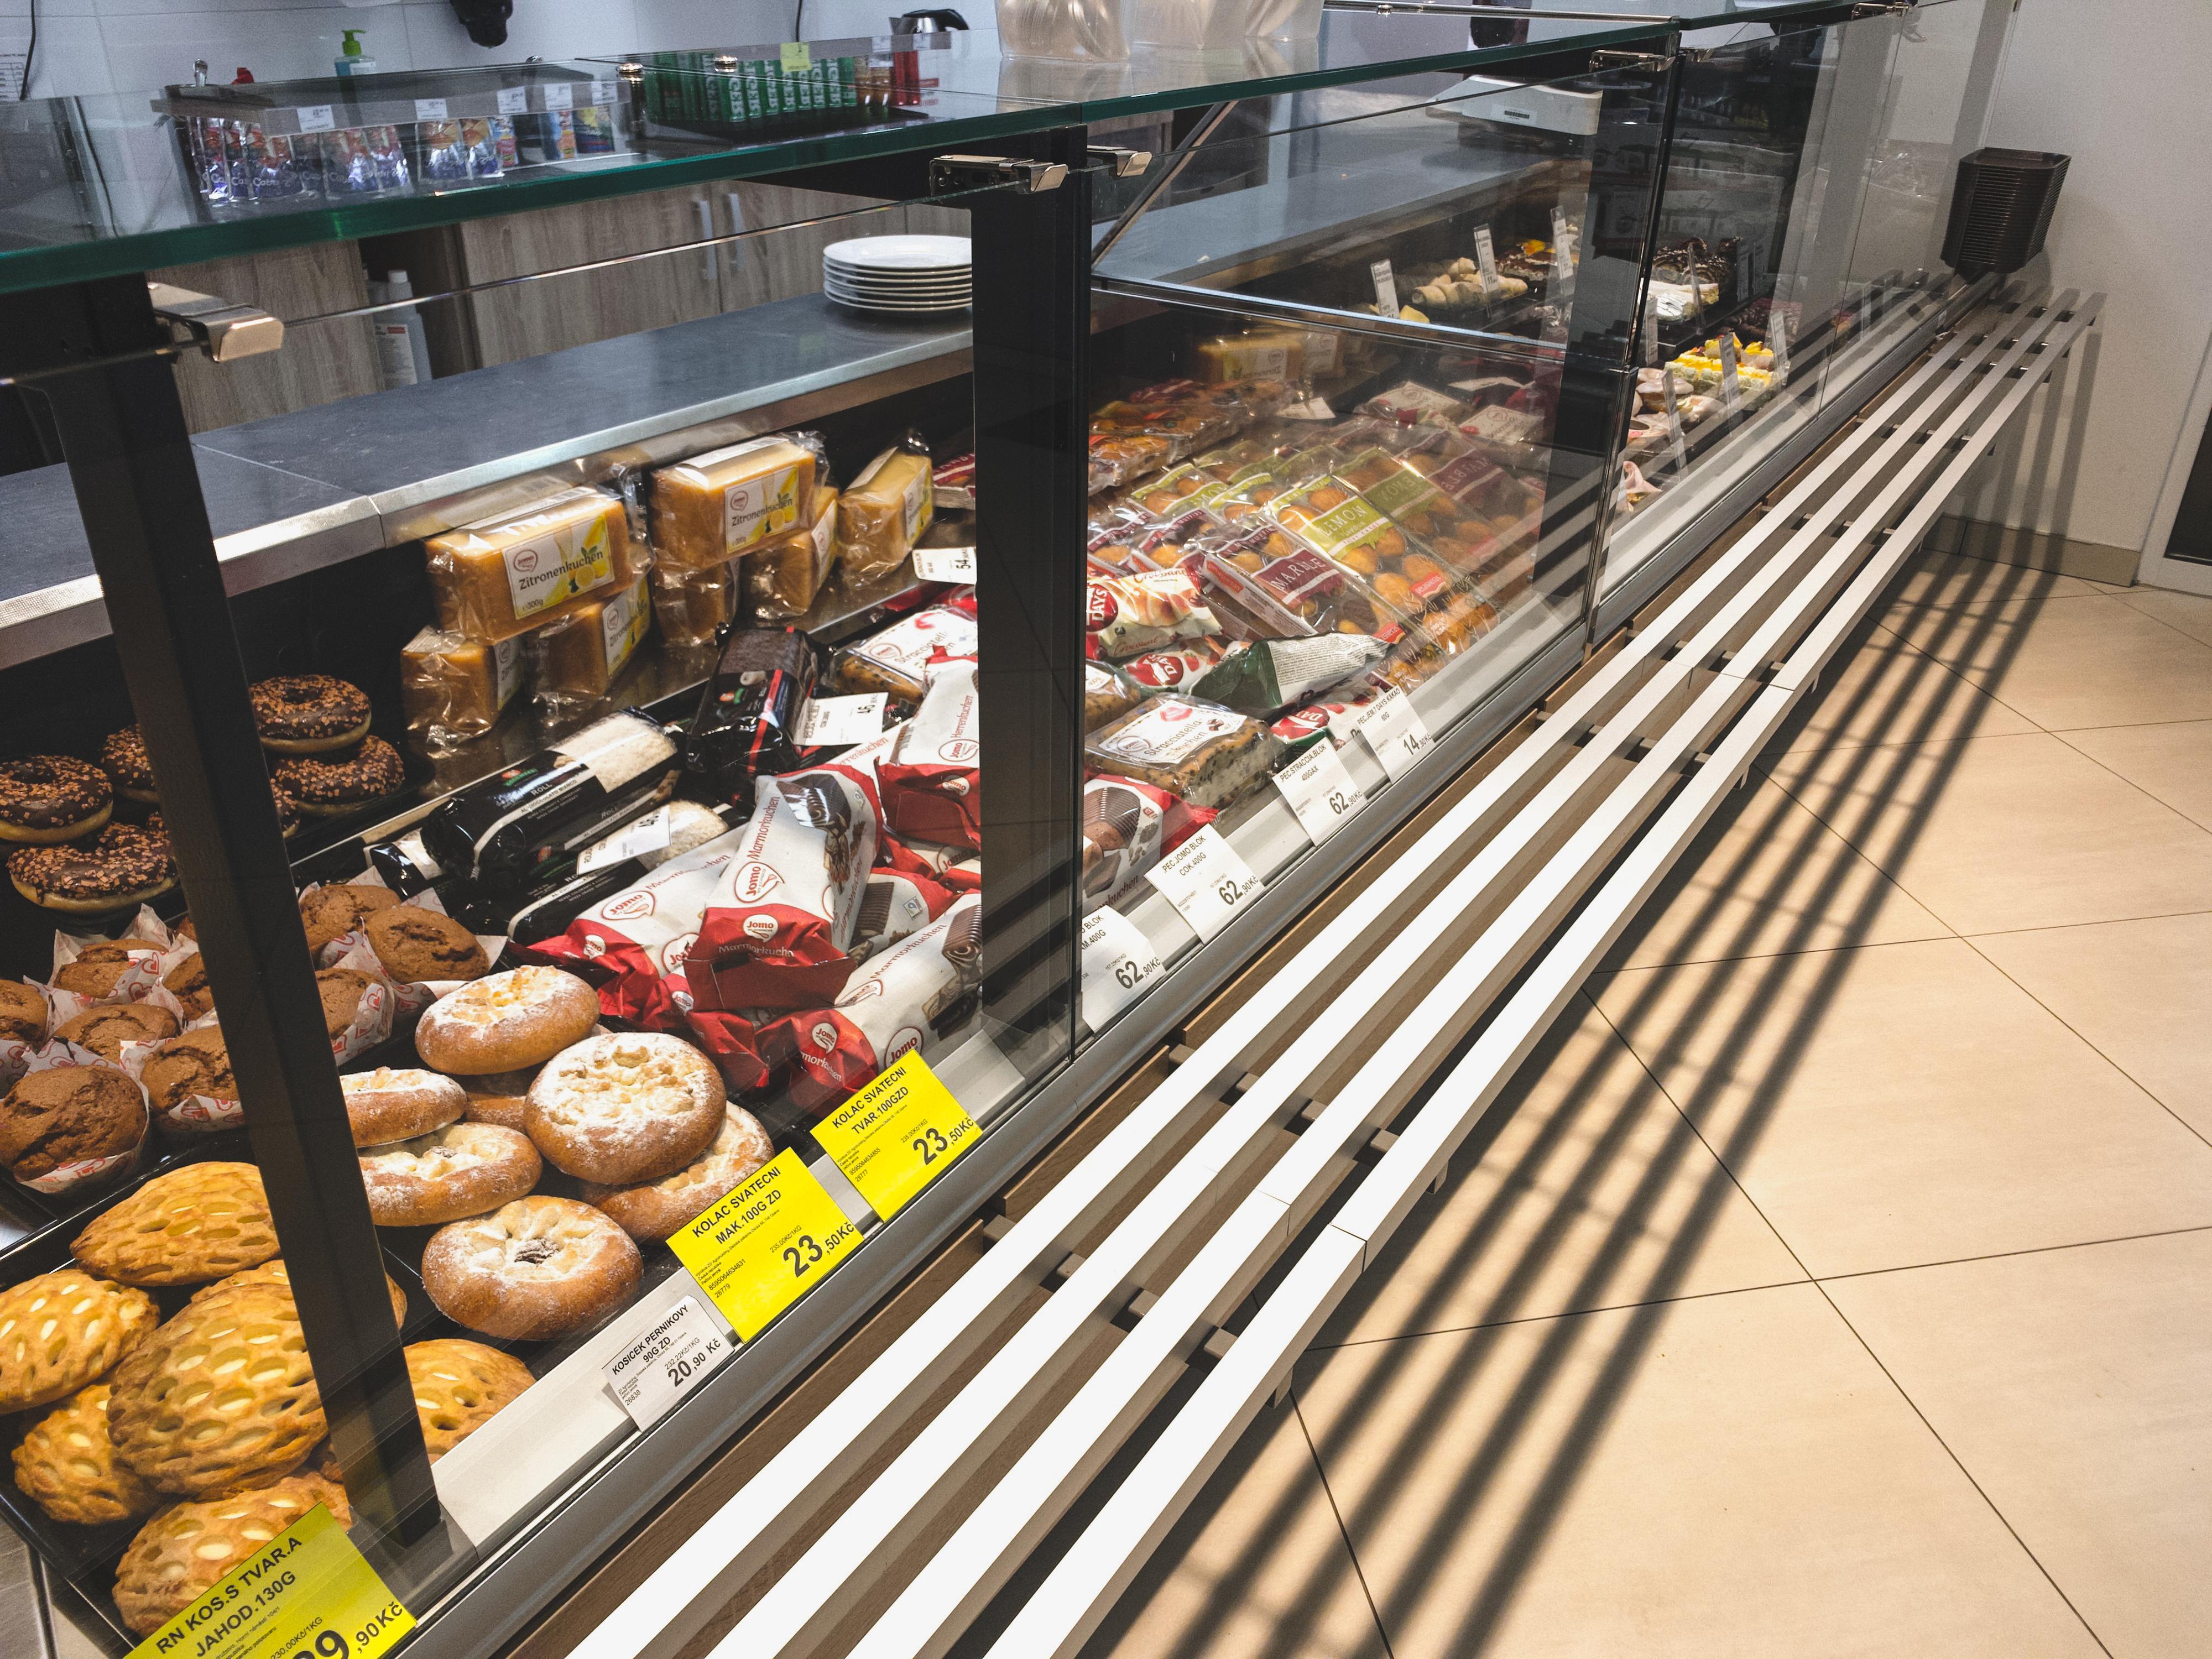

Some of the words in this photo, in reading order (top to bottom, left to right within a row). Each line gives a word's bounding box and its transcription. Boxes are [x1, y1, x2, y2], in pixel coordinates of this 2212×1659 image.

[732, 498, 793, 526] Zitronenkuchen
[1318, 505, 1368, 537] LEMON
[519, 551, 604, 590] Zitronenkuchen
[1091, 588, 1108, 622] DAYS
[949, 742, 963, 759] Jomo
[530, 783, 553, 796] ROLL
[747, 797, 780, 861] Marmorkuchen
[1189, 835, 1207, 851] BLOK
[746, 866, 761, 897] Jomo
[609, 894, 643, 915] Jomo
[746, 920, 774, 929] Jomo
[1084, 915, 1104, 930] BLOK
[870, 924, 947, 979] Marmorkuchen
[816, 1027, 836, 1044] Jomo
[889, 1036, 919, 1065] Jomo
[832, 1099, 865, 1129] KOLAC
[863, 1066, 907, 1103] SVATECNI
[692, 1204, 731, 1238] KOLAC
[729, 1166, 781, 1209] SVATECNI
[714, 1200, 767, 1244] MAK.100G
[765, 1189, 781, 1206] ZD
[708, 1258, 746, 1291] 8595064634831
[714, 1284, 731, 1298] 28779
[612, 1341, 646, 1375] KOSICEK
[644, 1304, 689, 1345] PERNIKOVY
[643, 1346, 660, 1363] 90G
[658, 1336, 671, 1350] ZD
[706, 1338, 721, 1354] Kč
[624, 1389, 641, 1406] 26838
[155, 1626, 187, 1655] RN
[184, 1583, 240, 1633] KOS.S
[238, 1536, 302, 1588] TVAR.A
[195, 1570, 296, 1658] JAHOD.130G
